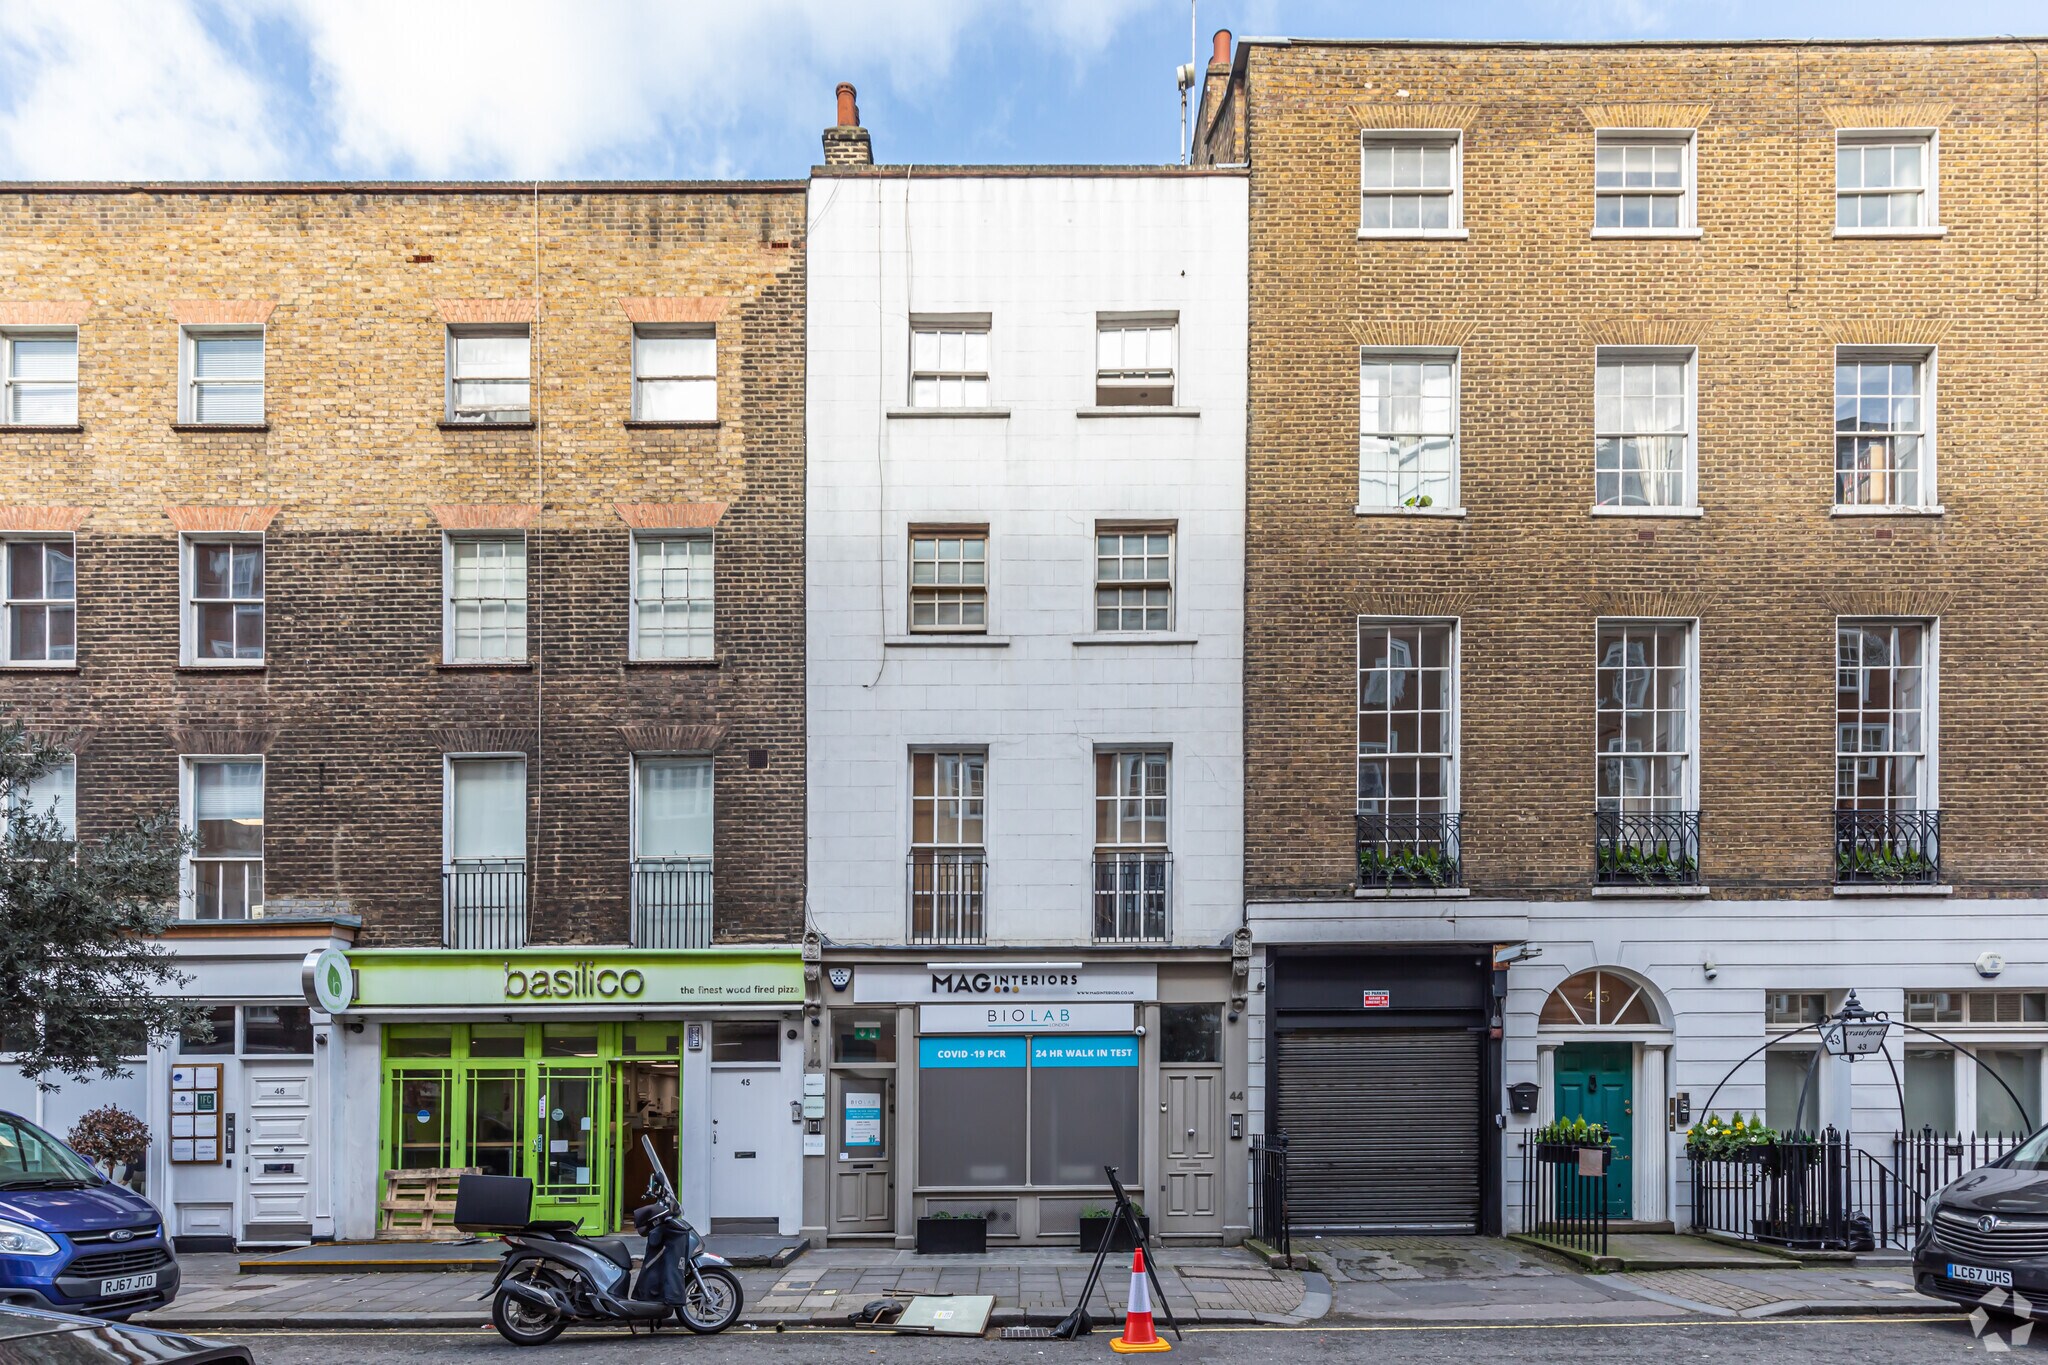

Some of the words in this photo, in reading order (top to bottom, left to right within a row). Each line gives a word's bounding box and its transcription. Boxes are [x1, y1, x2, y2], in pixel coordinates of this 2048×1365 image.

[504, 961, 645, 997] basilico
[932, 973, 991, 993] MAG
[994, 975, 1078, 986] INTERIORS
[680, 986, 695, 994] the
[698, 985, 723, 994] finest
[726, 985, 751, 994] wood
[754, 985, 775, 994] fired
[777, 985, 800, 995] pizza
[1584, 991, 1610, 1003] 43
[988, 1009, 1070, 1022] BIOLAB
[1845, 1028, 1886, 1038] crawfords
[1829, 1034, 1841, 1046] 43
[937, 1050, 968, 1059] COVID
[970, 1049, 985, 1058] -19
[987, 1049, 1006, 1058] PCR
[1035, 1049, 1047, 1058] 24
[1049, 1049, 1063, 1058] HR
[1065, 1049, 1094, 1057] WALK
[1096, 1048, 1108, 1057] IN
[1110, 1048, 1132, 1057] TEST
[808, 1060, 822, 1069] 44
[274, 1087, 285, 1095] 46
[1229, 1091, 1244, 1101] 44
[116, 1231, 130, 1239] Ford
[1954, 1265, 1983, 1280] LC67
[1986, 1270, 2010, 1284] UHS
[105, 1278, 132, 1293] RJ67
[134, 1275, 153, 1288] JTO
